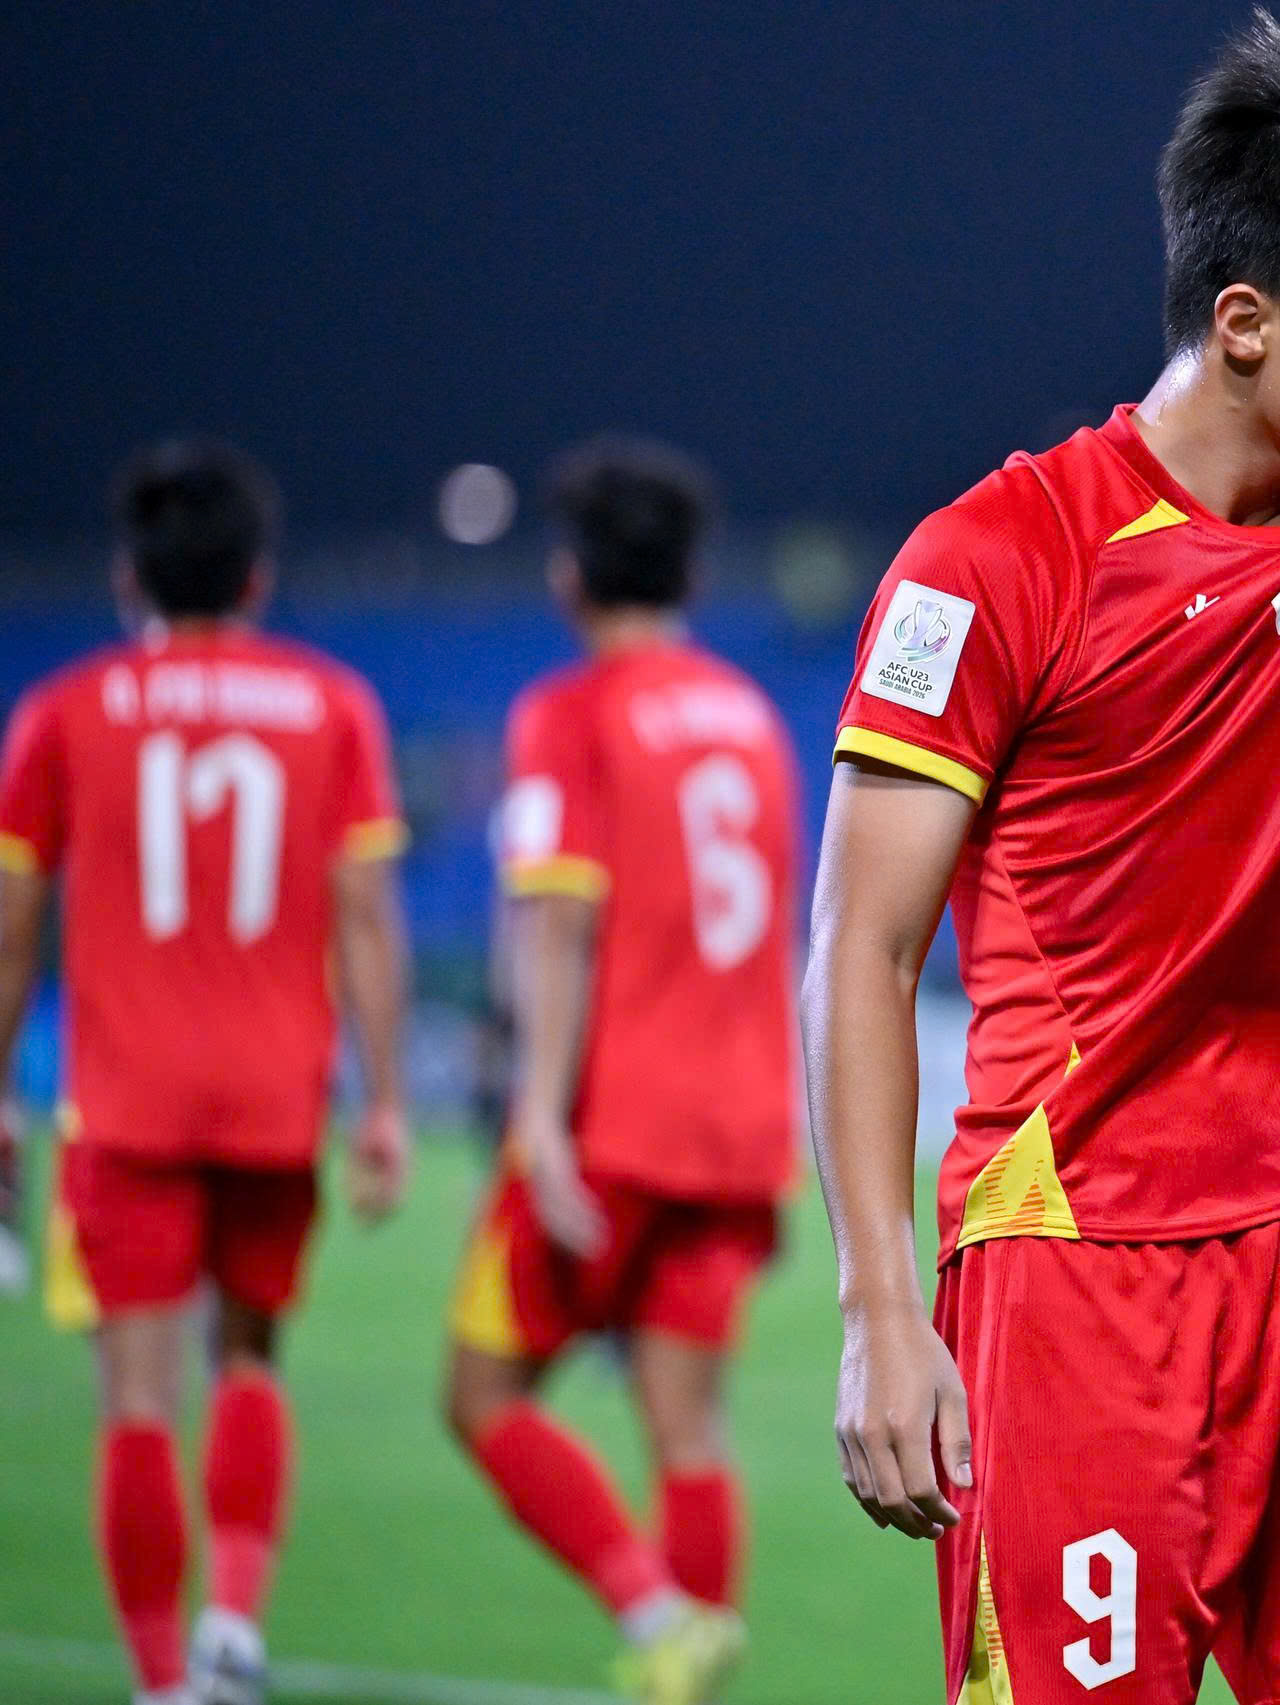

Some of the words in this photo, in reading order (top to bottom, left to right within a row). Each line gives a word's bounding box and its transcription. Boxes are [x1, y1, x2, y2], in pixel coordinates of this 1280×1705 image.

[878, 669, 910, 685] ASIAN
[911, 680, 933, 692] CUP
[887, 662, 908, 674] AFC
[910, 669, 929, 681] U23
[138, 731, 286, 944] 17
[679, 754, 772, 971] 6
[1062, 1528, 1138, 1690] 9
